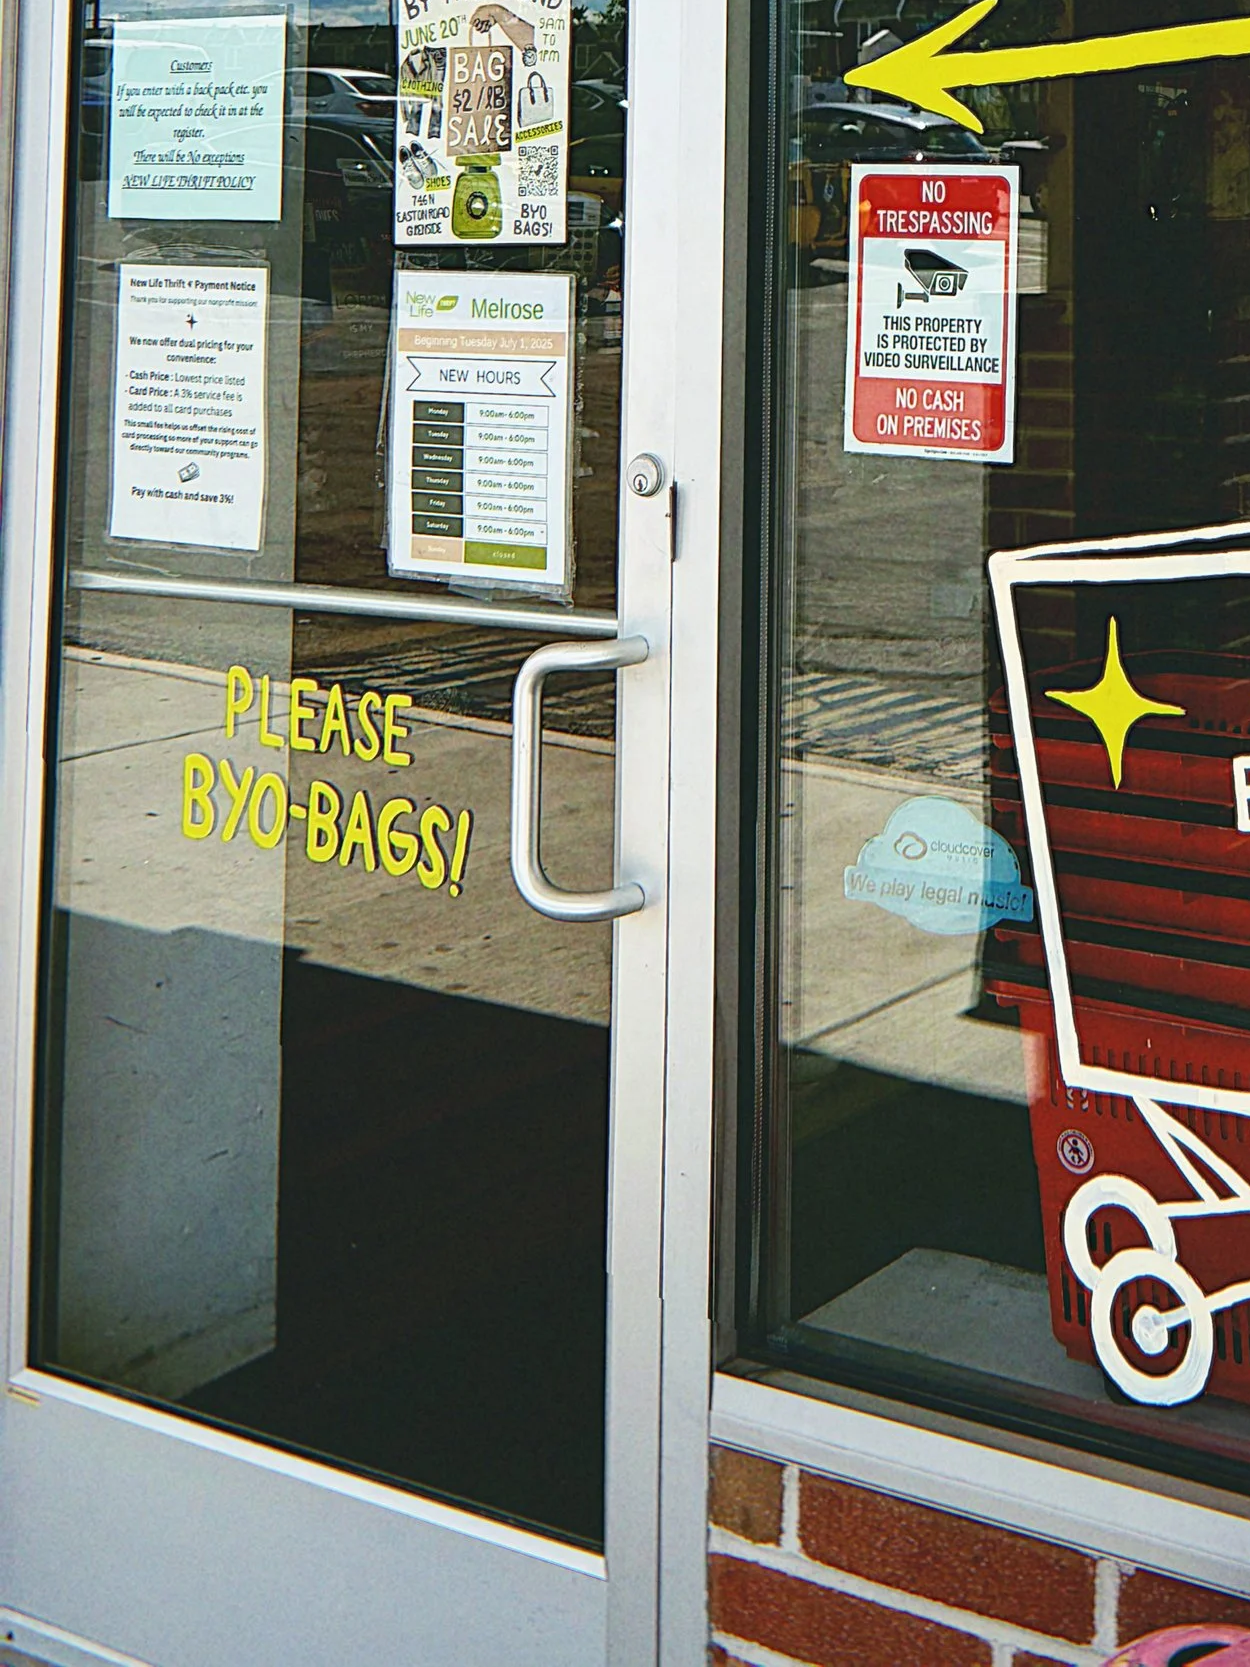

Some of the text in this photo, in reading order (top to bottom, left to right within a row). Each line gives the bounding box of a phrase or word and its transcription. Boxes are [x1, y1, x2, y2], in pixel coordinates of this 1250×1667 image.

[539, 17, 565, 30] 9AM
[401, 23, 437, 50] JUNE
[543, 33, 556, 46] TO
[538, 50, 560, 62] 1PM
[170, 60, 213, 72] Customers
[454, 50, 506, 84] BAG
[117, 84, 124, 101] If
[125, 88, 141, 101] you
[142, 86, 163, 96] enter
[164, 84, 185, 95] with
[193, 83, 213, 97] back
[213, 82, 235, 100] pack
[251, 85, 268, 99] you
[119, 103, 264, 121] will be expected to check it in at the
[173, 128, 205, 142] register.
[515, 121, 563, 141] ACCESSORIES
[133, 149, 245, 167] There will be No exceptions
[123, 174, 256, 190] NEW LIFE THRIFT POLICY
[426, 175, 451, 188] SHOES
[922, 180, 945, 203] NO
[521, 203, 547, 220] BYO
[514, 220, 552, 238] BAGS!
[877, 210, 993, 235] TRESPASSING
[130, 278, 256, 291] New Life Thrift Payment Notice
[406, 291, 436, 304] New
[410, 304, 434, 318] Life
[472, 298, 544, 320] Melrose
[883, 316, 983, 334] THIS PROPERTY
[129, 336, 253, 352] We now offer dual pricing for your
[414, 335, 457, 349] Beginning
[460, 336, 498, 350] Tuesday
[500, 337, 518, 350] July
[530, 339, 553, 349] 2025
[877, 334, 988, 354] IS PROTECTED BY
[167, 355, 217, 364] convenience:
[864, 352, 1000, 373] VIDEO SURVEILLANCE
[129, 370, 246, 386] Cash Price Lowest price listed
[439, 369, 521, 385] NEW HOURS
[129, 386, 243, 402] Card Price A 3% service fee is
[896, 388, 965, 412] NO CASH
[128, 402, 232, 417] added to all card purchases
[428, 408, 449, 417] Monday
[509, 410, 535, 421] 6:00pm
[428, 430, 449, 440] Tuesday
[877, 414, 981, 441] ON PREMISES
[508, 434, 535, 445] 6:00pm
[423, 453, 453, 463] Wednesday
[507, 458, 534, 468] 6:00pm
[426, 476, 450, 486] Thursday
[508, 481, 534, 492] 6:00pm
[131, 486, 234, 504] Pay with cash and save 3%!
[429, 499, 446, 508] Friday
[507, 504, 534, 514] 6:00pm
[426, 521, 450, 531] Saturday
[508, 526, 534, 537] 6:00pm
[493, 551, 516, 560] closed
[225, 665, 413, 766] PLEASE
[182, 753, 471, 897] BYO-BAGS!
[931, 840, 995, 858] cloudcover
[851, 873, 1027, 912] We play legal music!
